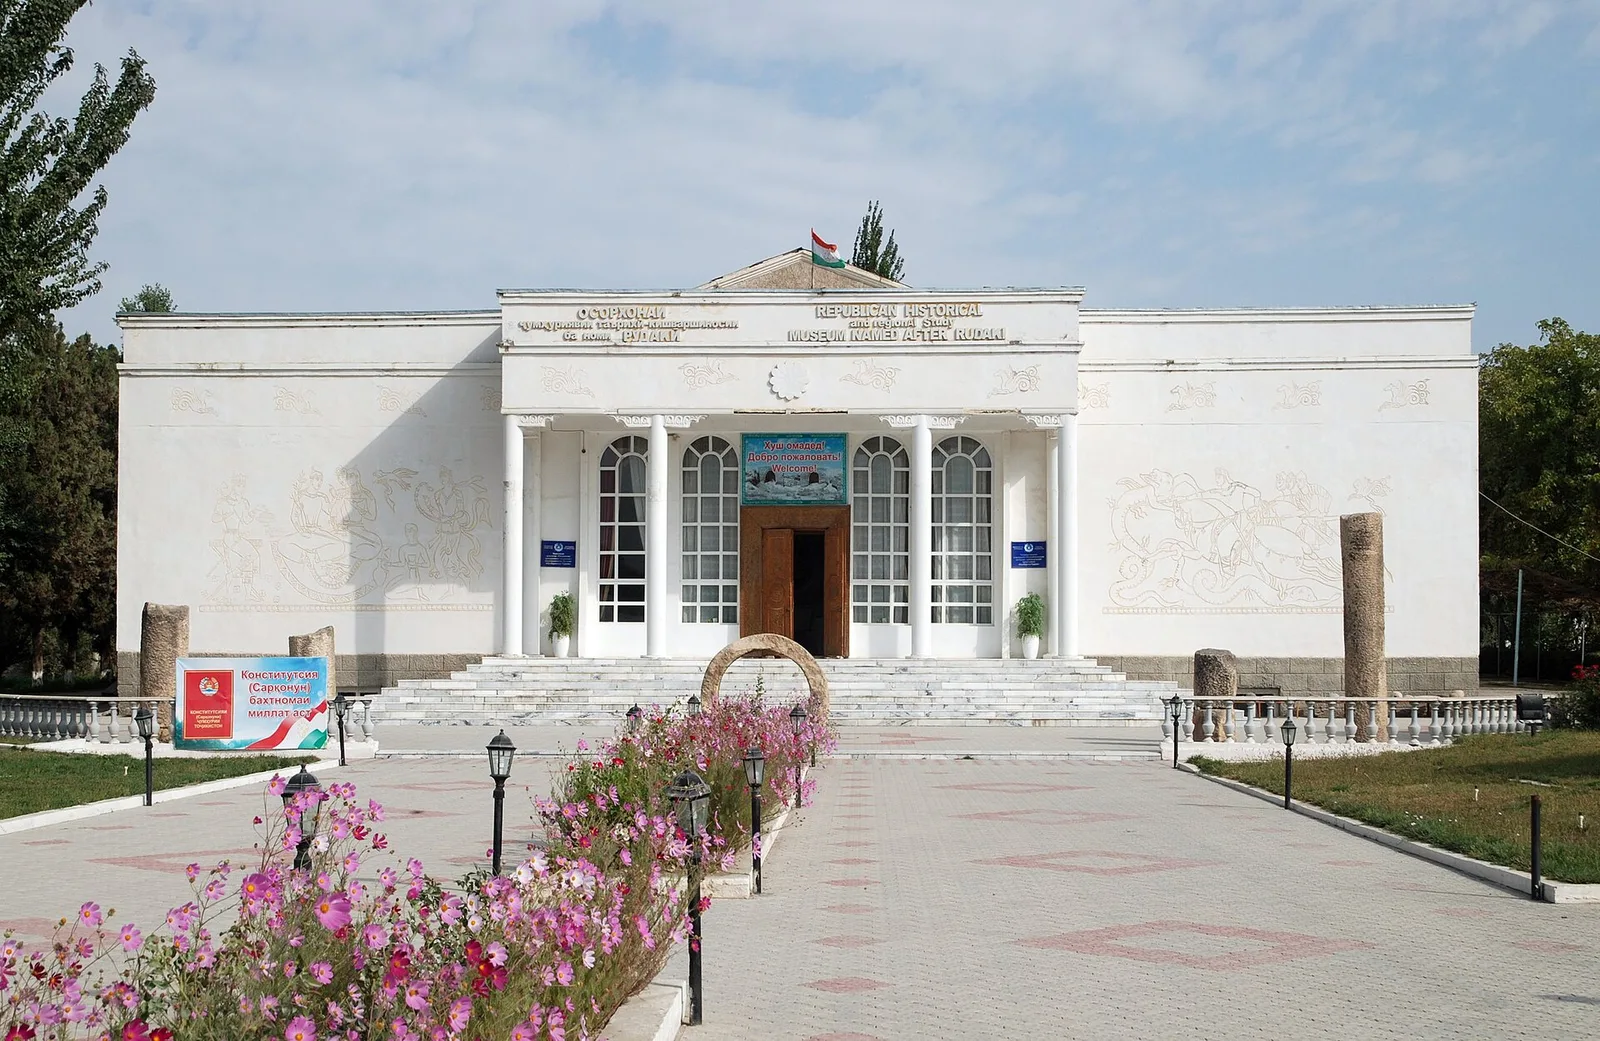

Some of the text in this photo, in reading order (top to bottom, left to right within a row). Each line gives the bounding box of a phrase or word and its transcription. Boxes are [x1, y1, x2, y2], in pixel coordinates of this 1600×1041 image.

[577, 307, 666, 319] ОСОРХОНАИ
[815, 303, 983, 318] REPUBLICAN HISTORICAL
[849, 319, 870, 328] and
[922, 318, 954, 329] Study
[562, 332, 578, 341] ба
[581, 333, 612, 341] номи
[788, 327, 1006, 342] MUSEUM NAMED AFTER RUDAKI
[764, 441, 825, 451] Хуш омадед!
[747, 452, 841, 462] Добро пожаловать!
[772, 464, 817, 472] Welcome!
[241, 670, 319, 681] Конститутсия
[249, 695, 310, 705] бахтномаи
[248, 709, 312, 717] миллат аст
